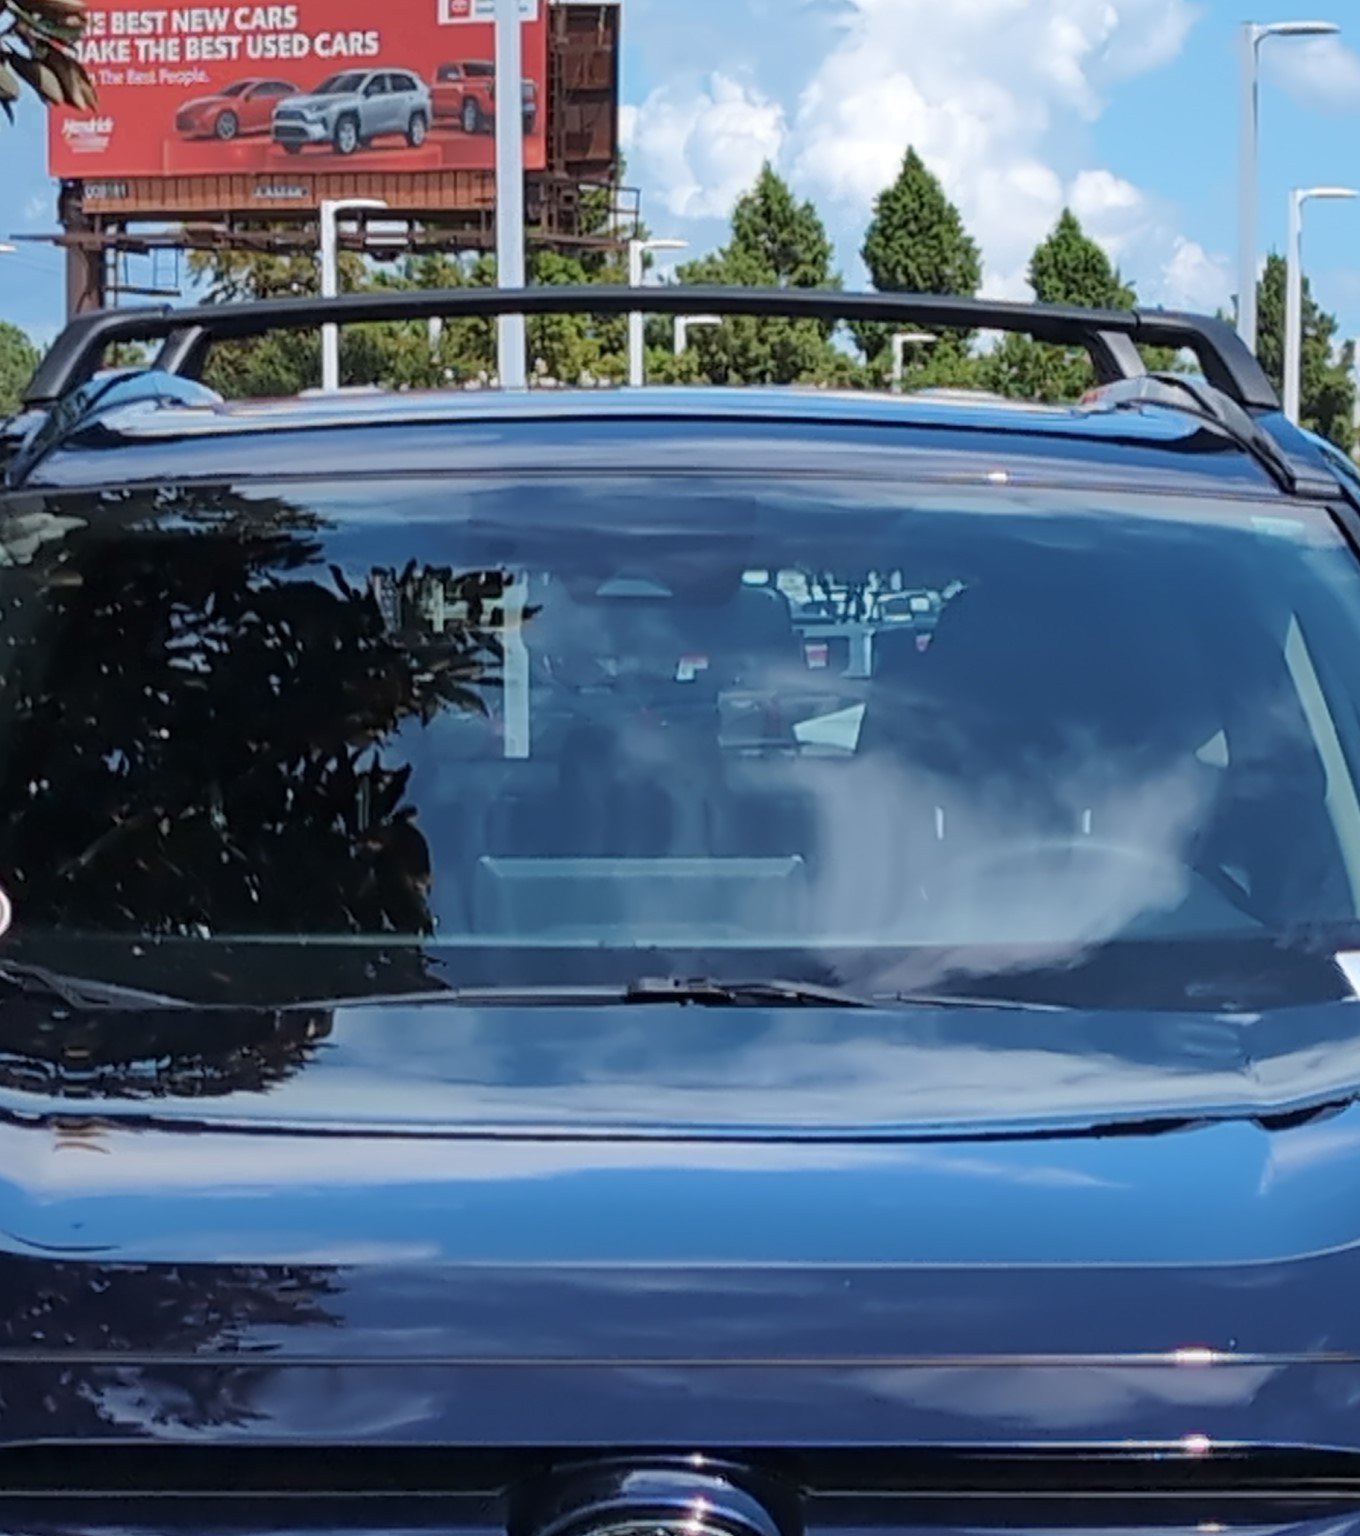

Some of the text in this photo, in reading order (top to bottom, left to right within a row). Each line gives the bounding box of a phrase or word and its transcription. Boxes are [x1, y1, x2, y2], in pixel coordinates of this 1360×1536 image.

[111, 9, 167, 35] BEST
[171, 7, 230, 33] NEW
[234, 5, 298, 31] CARS
[135, 37, 181, 62] THE
[185, 35, 242, 60] BEST
[246, 33, 310, 59] USED
[314, 31, 380, 57] CARS
[100, 69, 123, 85] The
